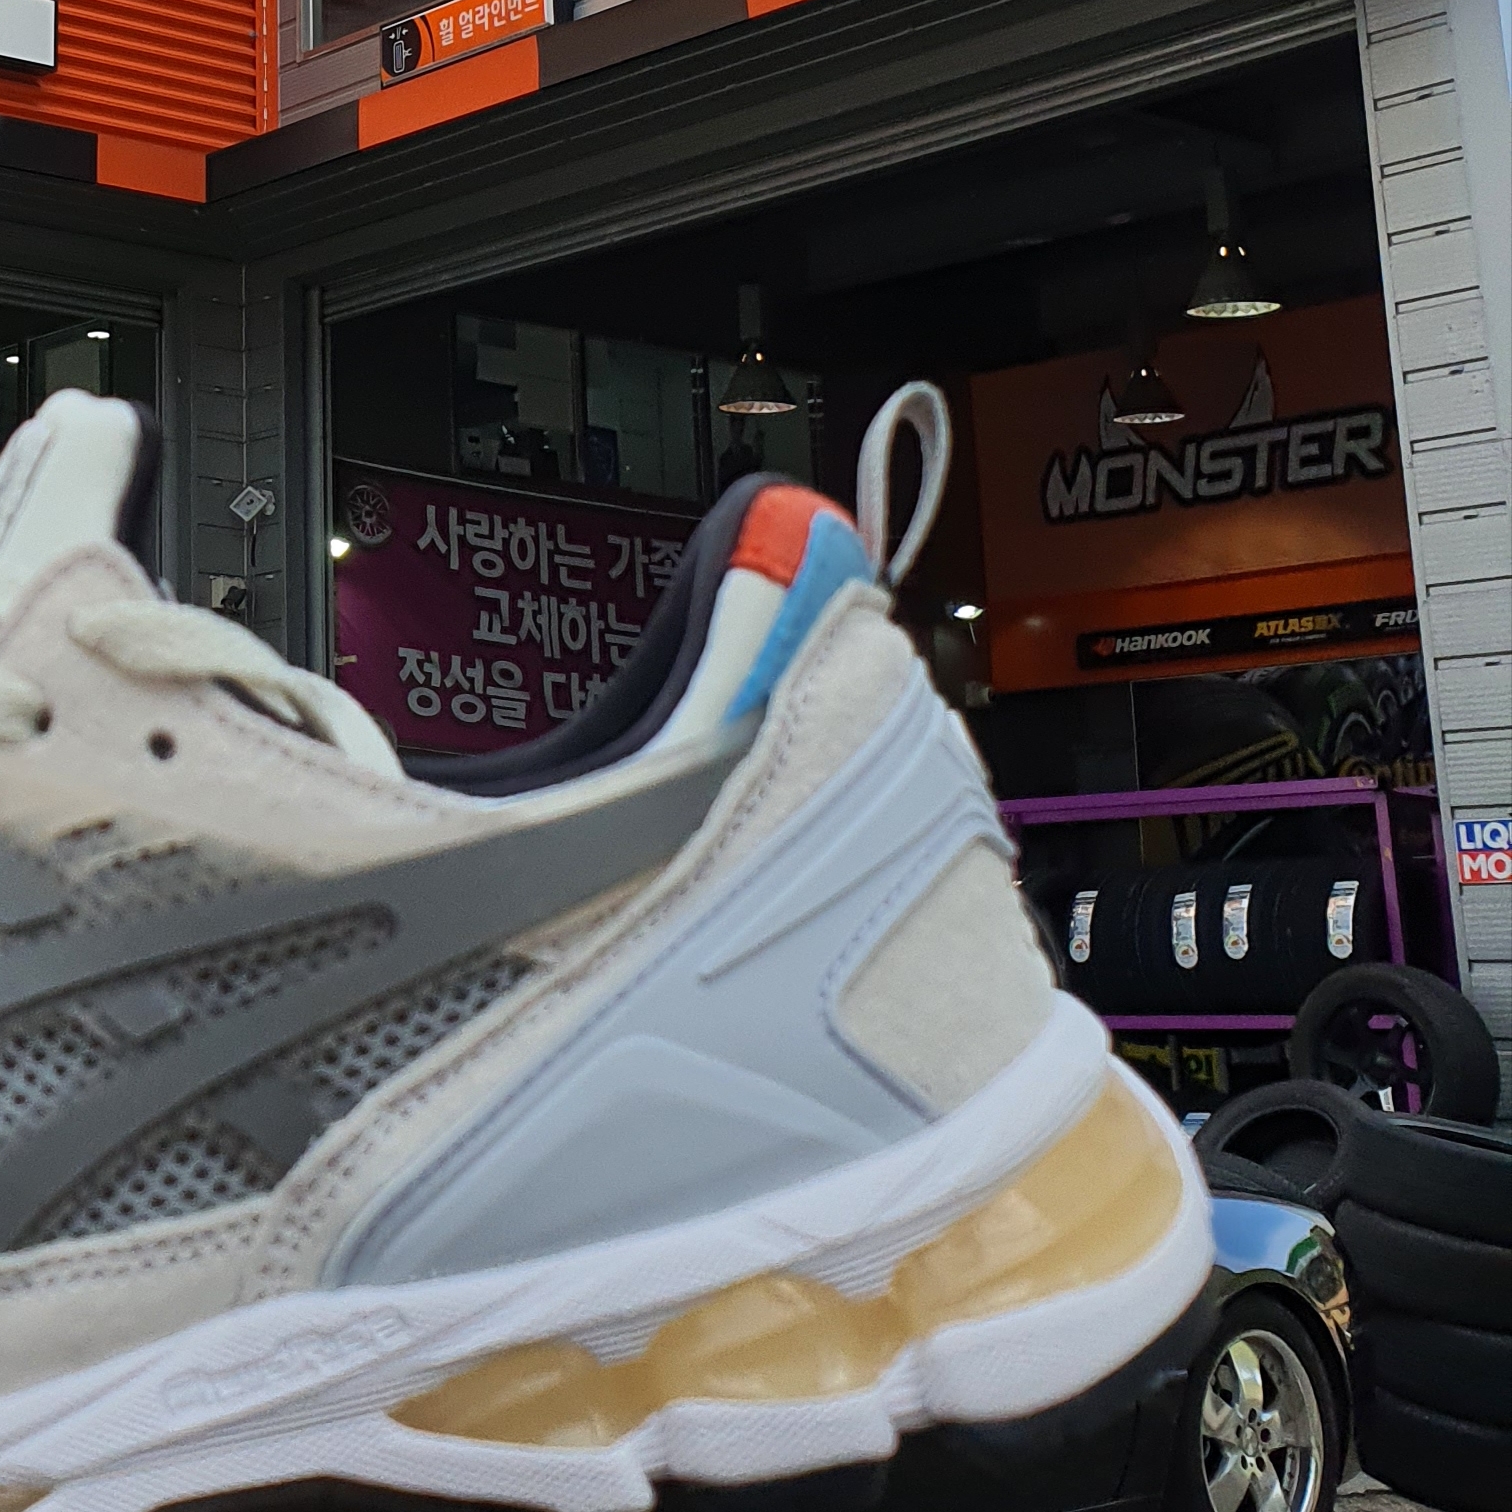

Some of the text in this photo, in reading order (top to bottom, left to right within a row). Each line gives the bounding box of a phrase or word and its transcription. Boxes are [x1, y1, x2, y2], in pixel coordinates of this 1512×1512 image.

[439, 16, 454, 46] 휠
[1043, 407, 1386, 522] MONSTER
[417, 504, 595, 589] 사랑하는
[472, 586, 641, 664] 교체하는
[1373, 609, 1419, 627] FRI
[398, 646, 530, 730] 정성을
